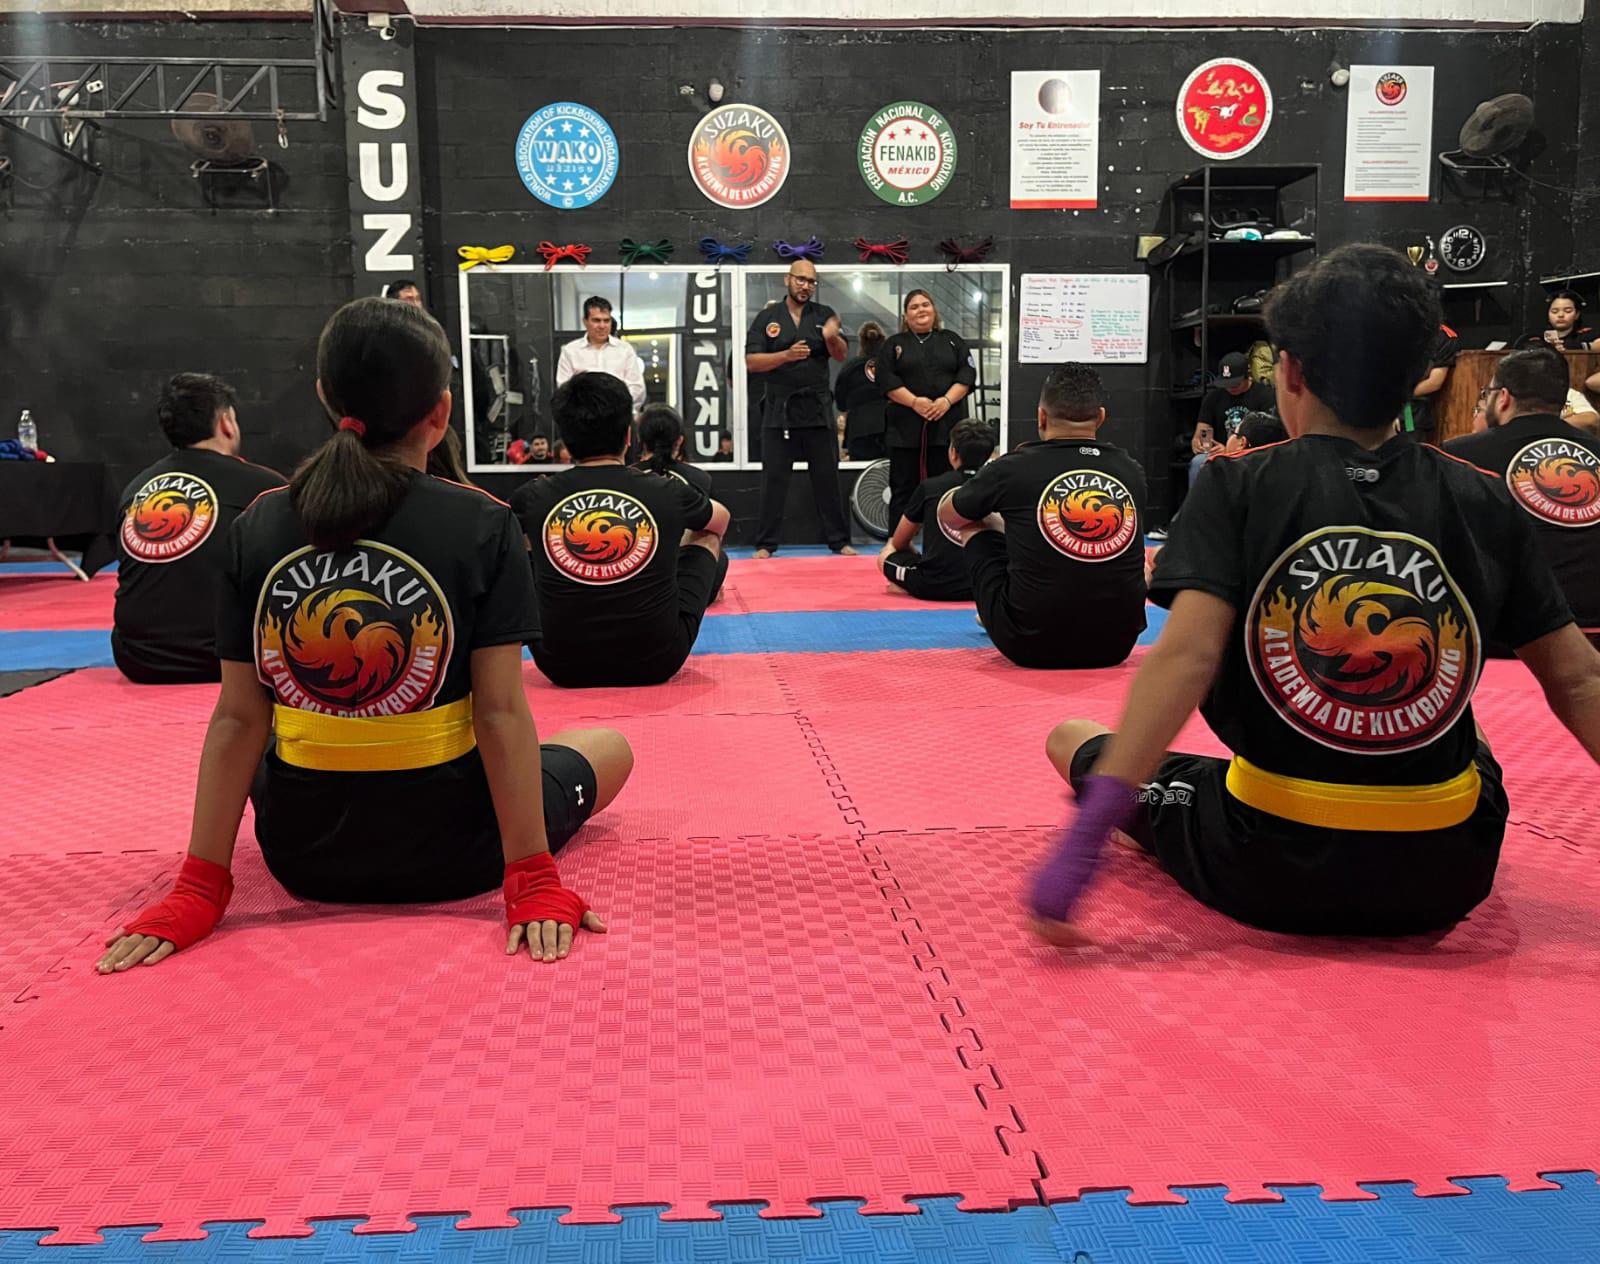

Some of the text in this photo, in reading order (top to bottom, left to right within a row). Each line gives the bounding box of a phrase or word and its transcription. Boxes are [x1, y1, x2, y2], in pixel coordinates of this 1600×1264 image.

[704, 111, 776, 138] SUZAKU
[1019, 122, 1034, 130] Soy
[519, 106, 616, 201] WORLD ASSOCIATION OF KICKBOXING ORGANIZATIONS
[534, 140, 602, 164] WAKO
[861, 105, 954, 191] FEDERACIÓN NACIONAL DE KICKBOXING
[880, 145, 936, 161] FENAKIB
[357, 70, 414, 298] SUZ
[696, 156, 782, 200] ACADEMIA DE KICKBOXING
[898, 192, 918, 203] A.C.
[1458, 228, 1469, 239] 12
[1521, 443, 1596, 467] SUZAKU
[561, 494, 643, 520] SUZAKU
[1054, 475, 1128, 500] SUZAKU
[1517, 481, 1561, 518] ACADEMIA
[1562, 507, 1575, 520] DE
[145, 543, 158, 555] DE
[158, 514, 208, 555] KICKBOXING
[1046, 512, 1079, 552] ACADEMIA
[1081, 543, 1094, 554] DE
[550, 534, 650, 577] ACADEMIA DE KICKBOXING
[1288, 538, 1448, 603] SUZAKU
[271, 551, 428, 610] SUZAKU
[1264, 627, 1461, 736] ACADEMIA DE KICKBOXING
